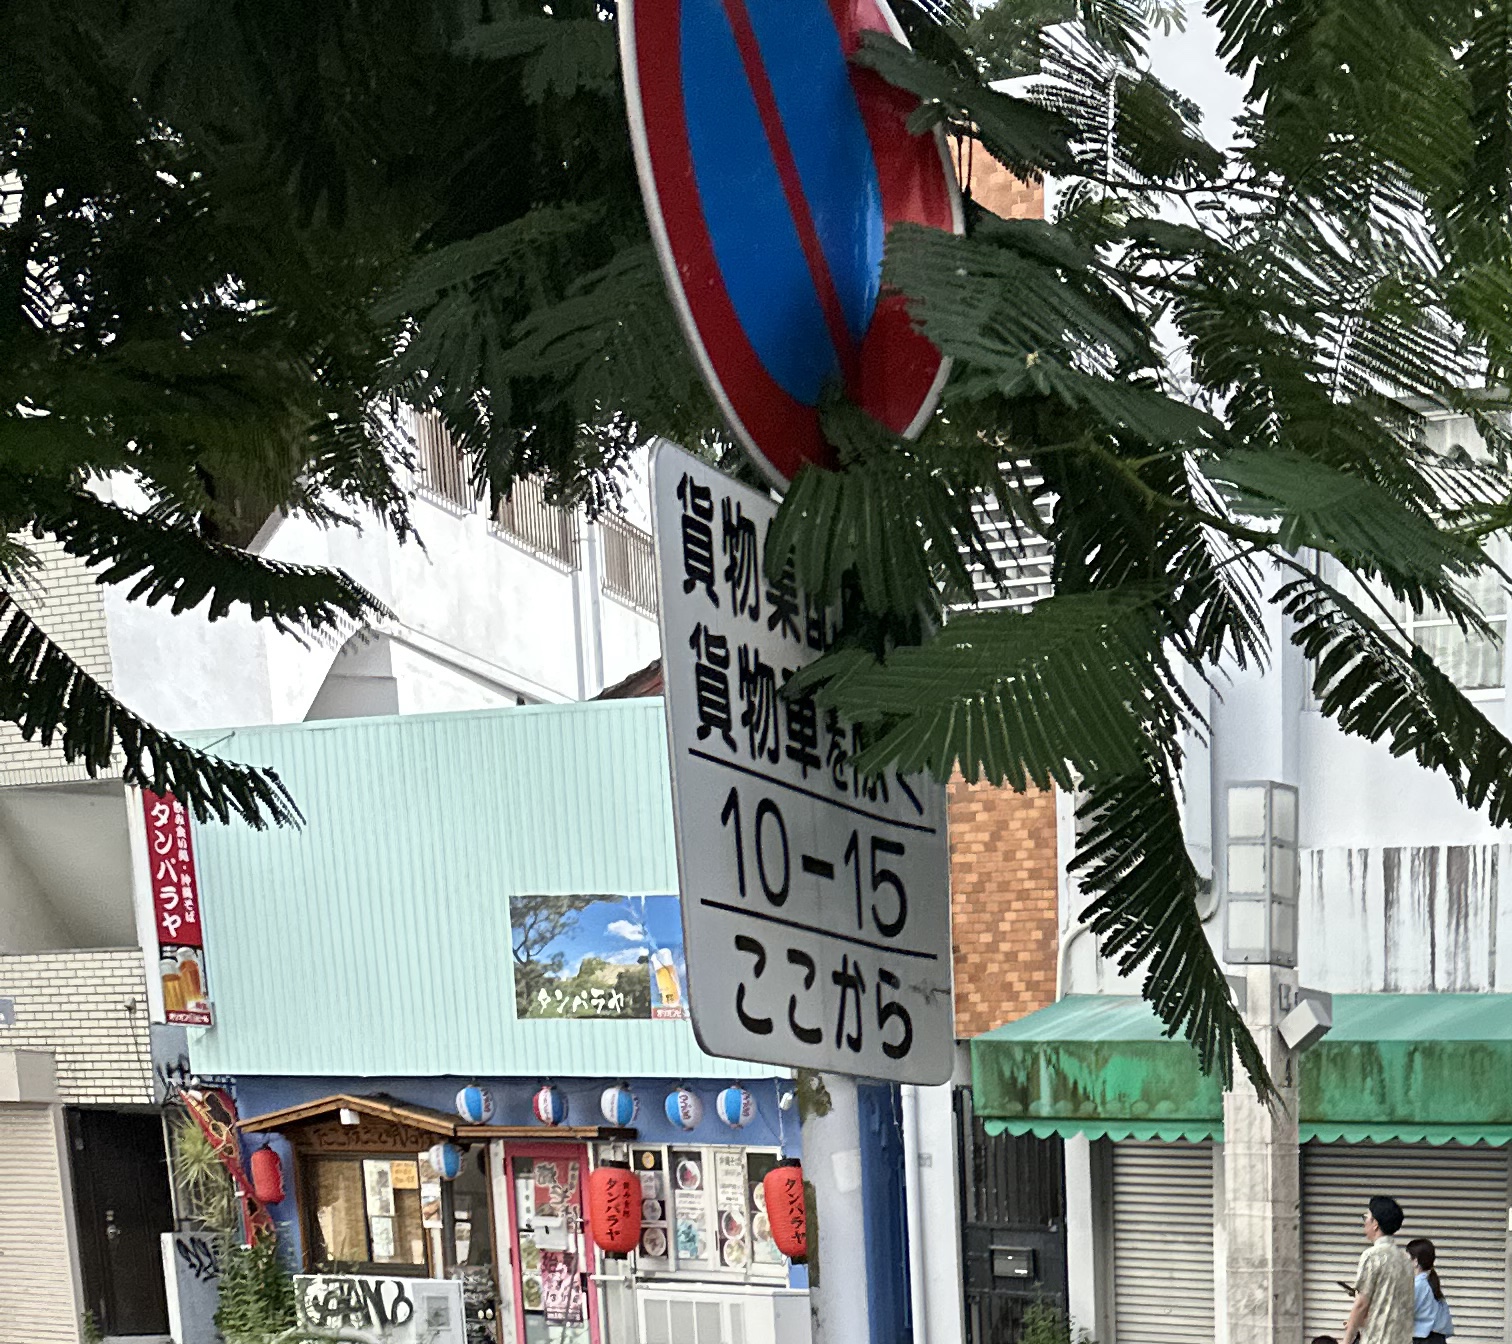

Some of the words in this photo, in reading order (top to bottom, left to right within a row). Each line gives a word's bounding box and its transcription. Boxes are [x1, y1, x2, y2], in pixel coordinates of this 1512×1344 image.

[720, 785, 909, 938] 10-15
[734, 933, 914, 1060] ここから
